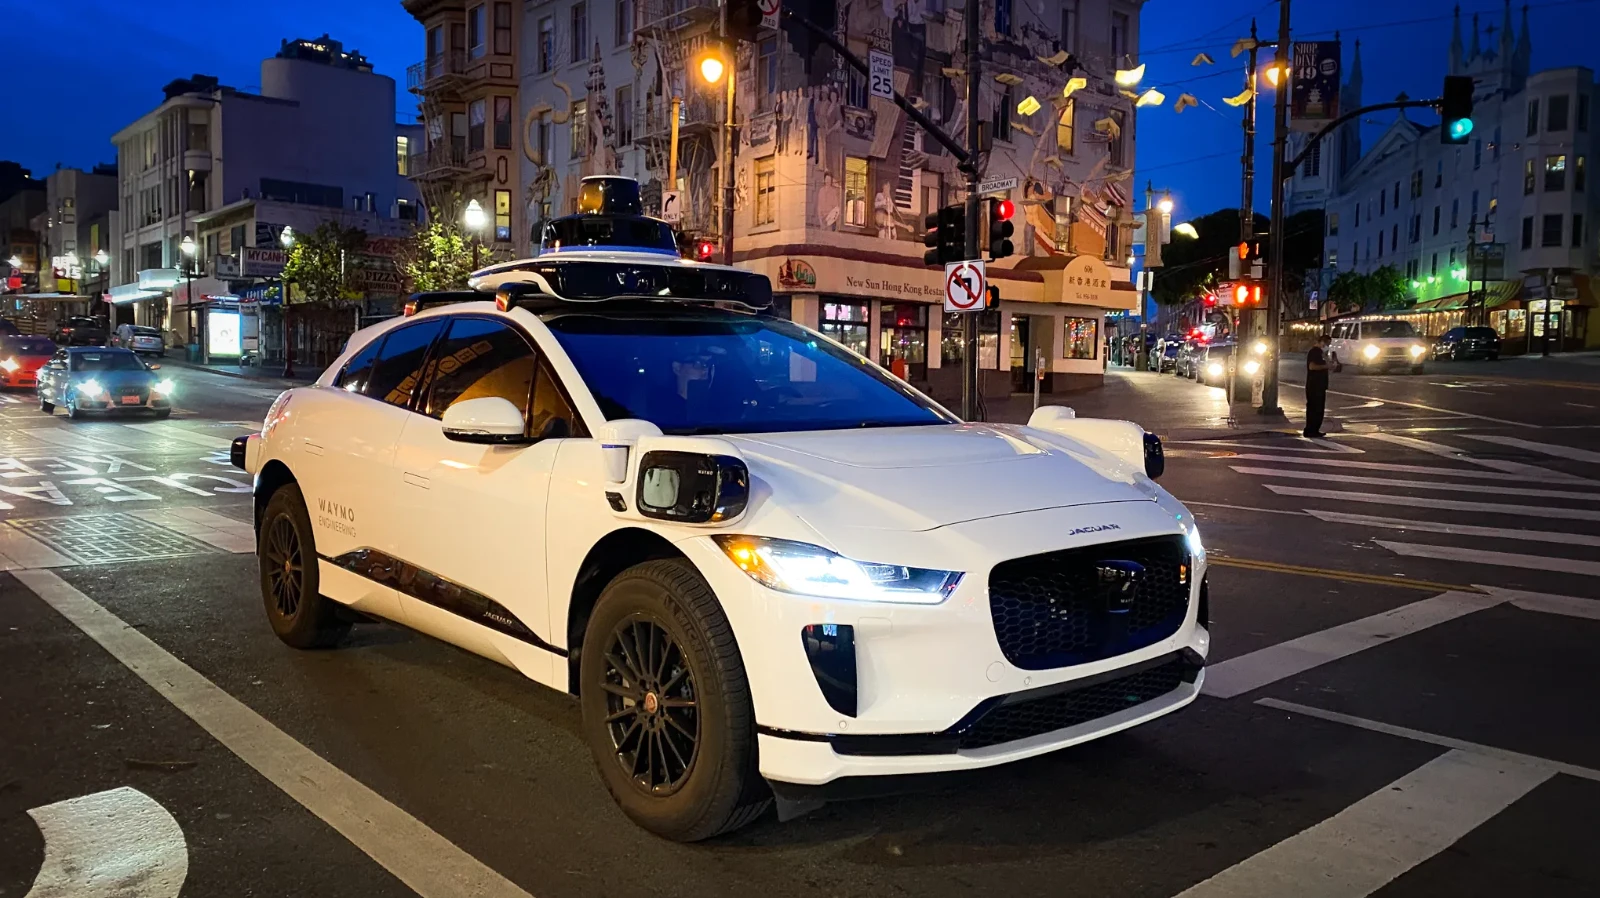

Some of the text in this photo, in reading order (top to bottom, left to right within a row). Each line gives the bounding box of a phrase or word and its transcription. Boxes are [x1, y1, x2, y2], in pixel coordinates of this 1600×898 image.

[763, 16, 777, 28] RED
[1295, 42, 1318, 55] SHOP
[871, 55, 892, 68] SPEED
[1295, 54, 1317, 67] DINE
[871, 65, 890, 76] LIMIT
[1295, 66, 1317, 80] 49
[872, 75, 892, 95] 25
[981, 179, 1013, 192] BROADWAY
[247, 250, 261, 261] MY
[1083, 265, 1093, 273] 606
[365, 271, 398, 282] PIZZA
[846, 276, 864, 288] New
[865, 278, 880, 290] Sun
[882, 280, 902, 294] Hong
[903, 282, 922, 296] Kong
[317, 496, 356, 523] WAYMO
[317, 515, 357, 539] ENGINEERING
[1067, 523, 1121, 536] JAGUAR
[482, 610, 513, 626] JAGUAR
